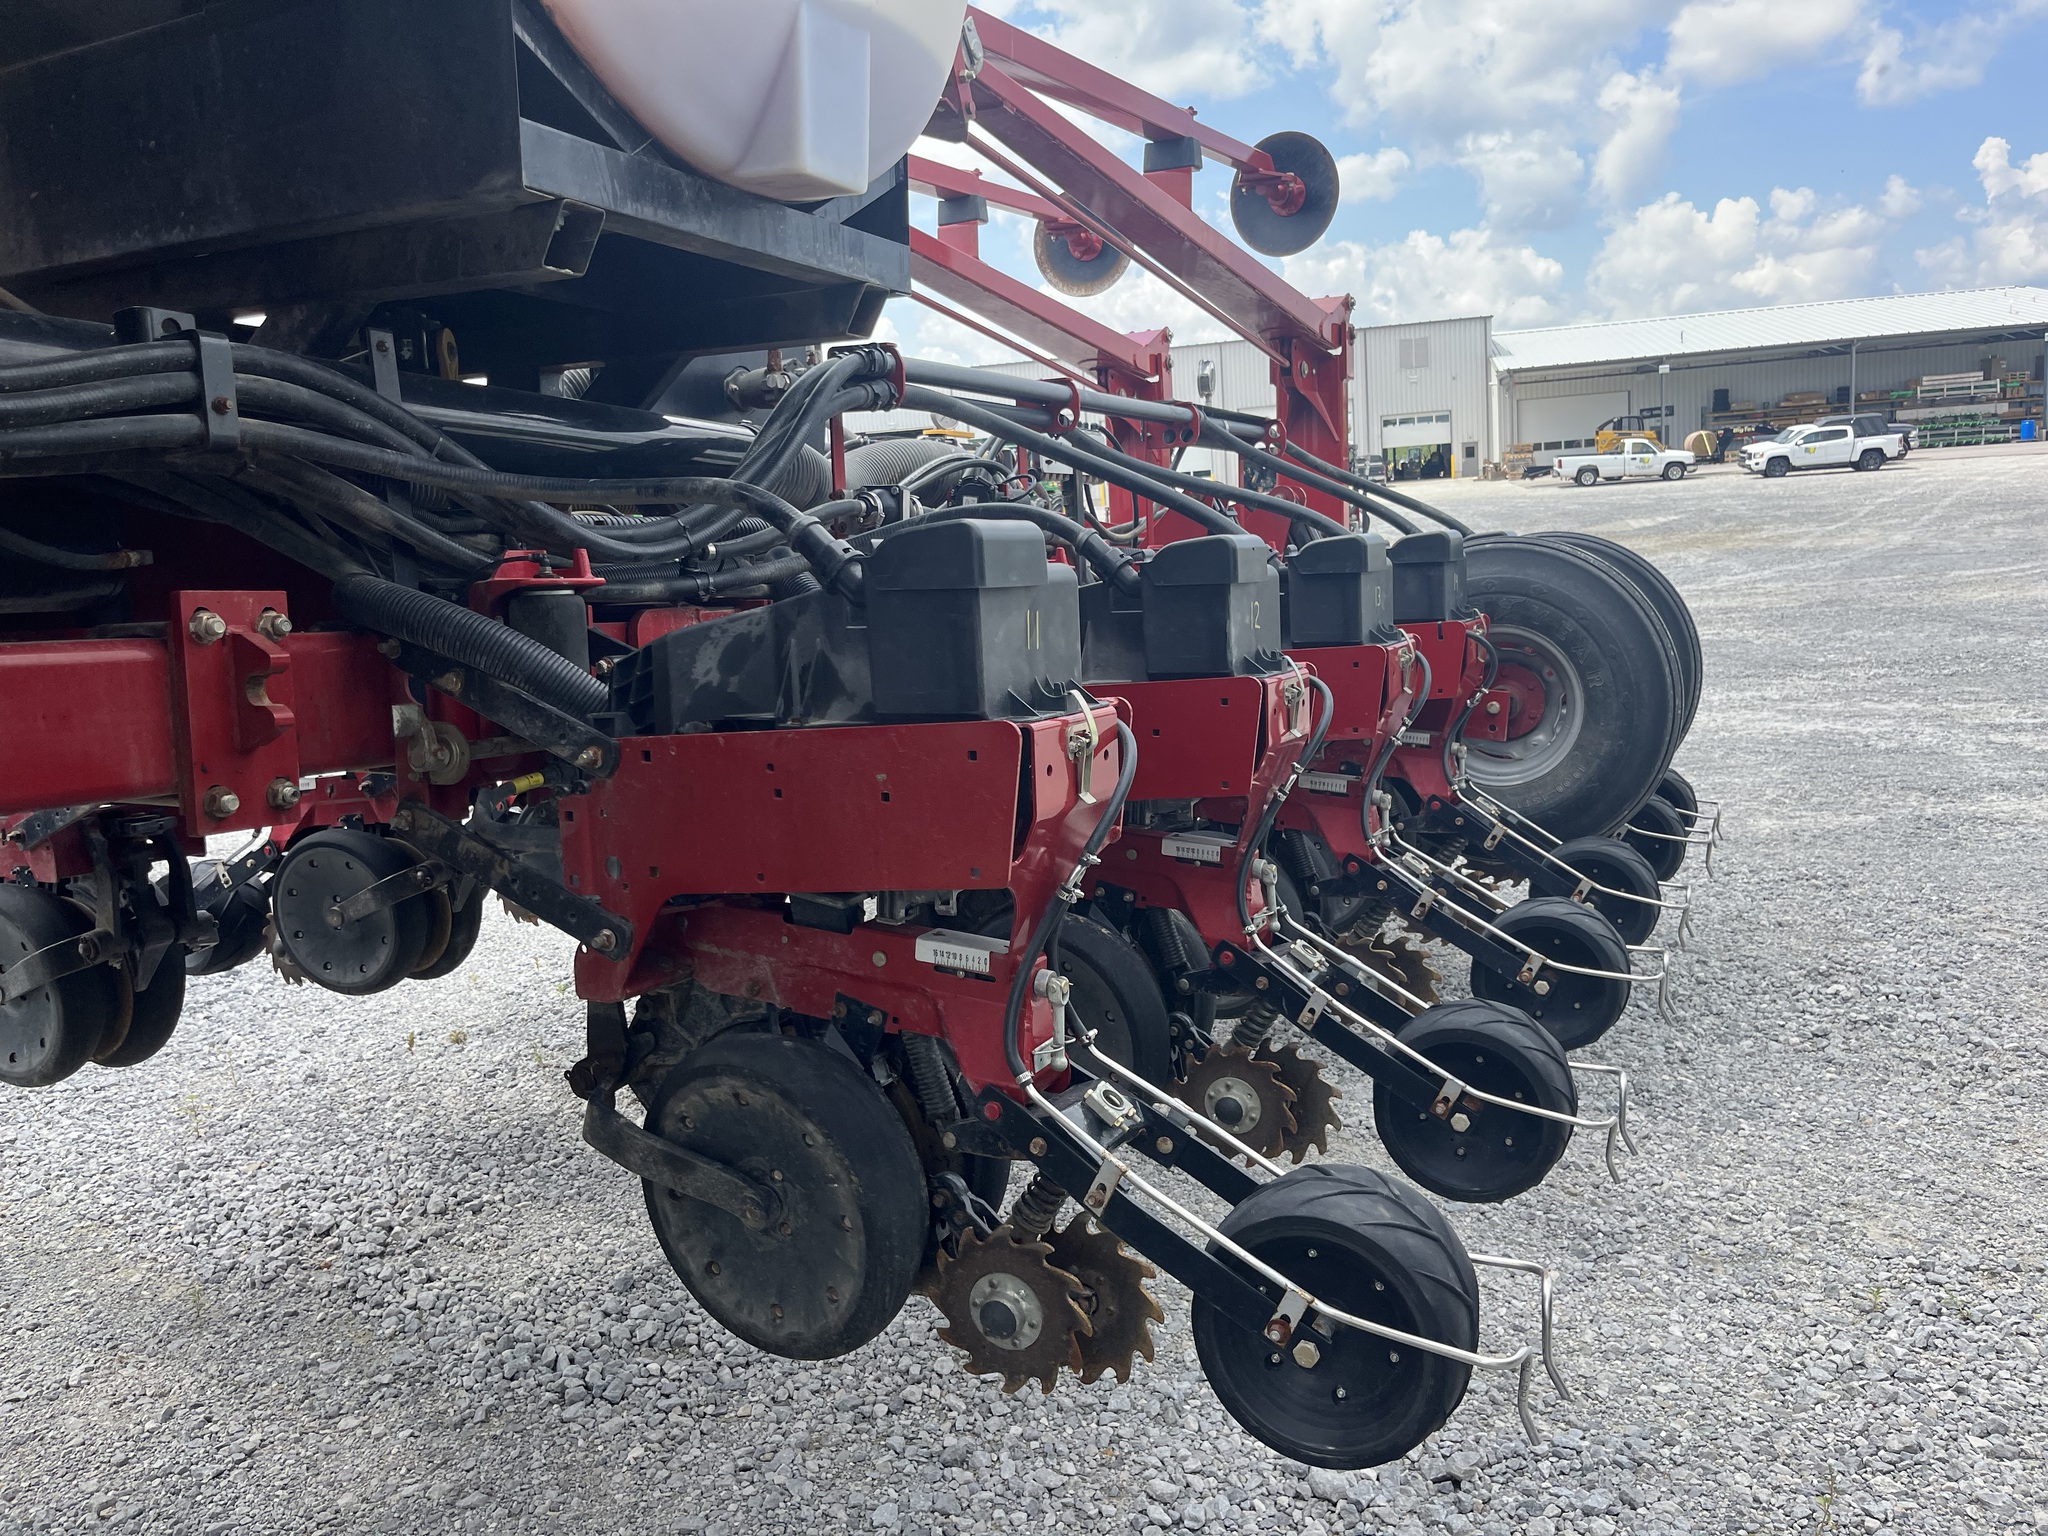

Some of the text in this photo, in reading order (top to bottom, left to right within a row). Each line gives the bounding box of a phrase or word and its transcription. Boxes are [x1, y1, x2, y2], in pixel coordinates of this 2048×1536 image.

[1375, 586, 1381, 606] 13
[1250, 600, 1261, 630] 12
[1026, 609, 1040, 650] 11
[939, 949, 944, 957] 14
[946, 951, 951, 959] 12
[951, 952, 957, 960] 10
[978, 956, 981, 964] 2
